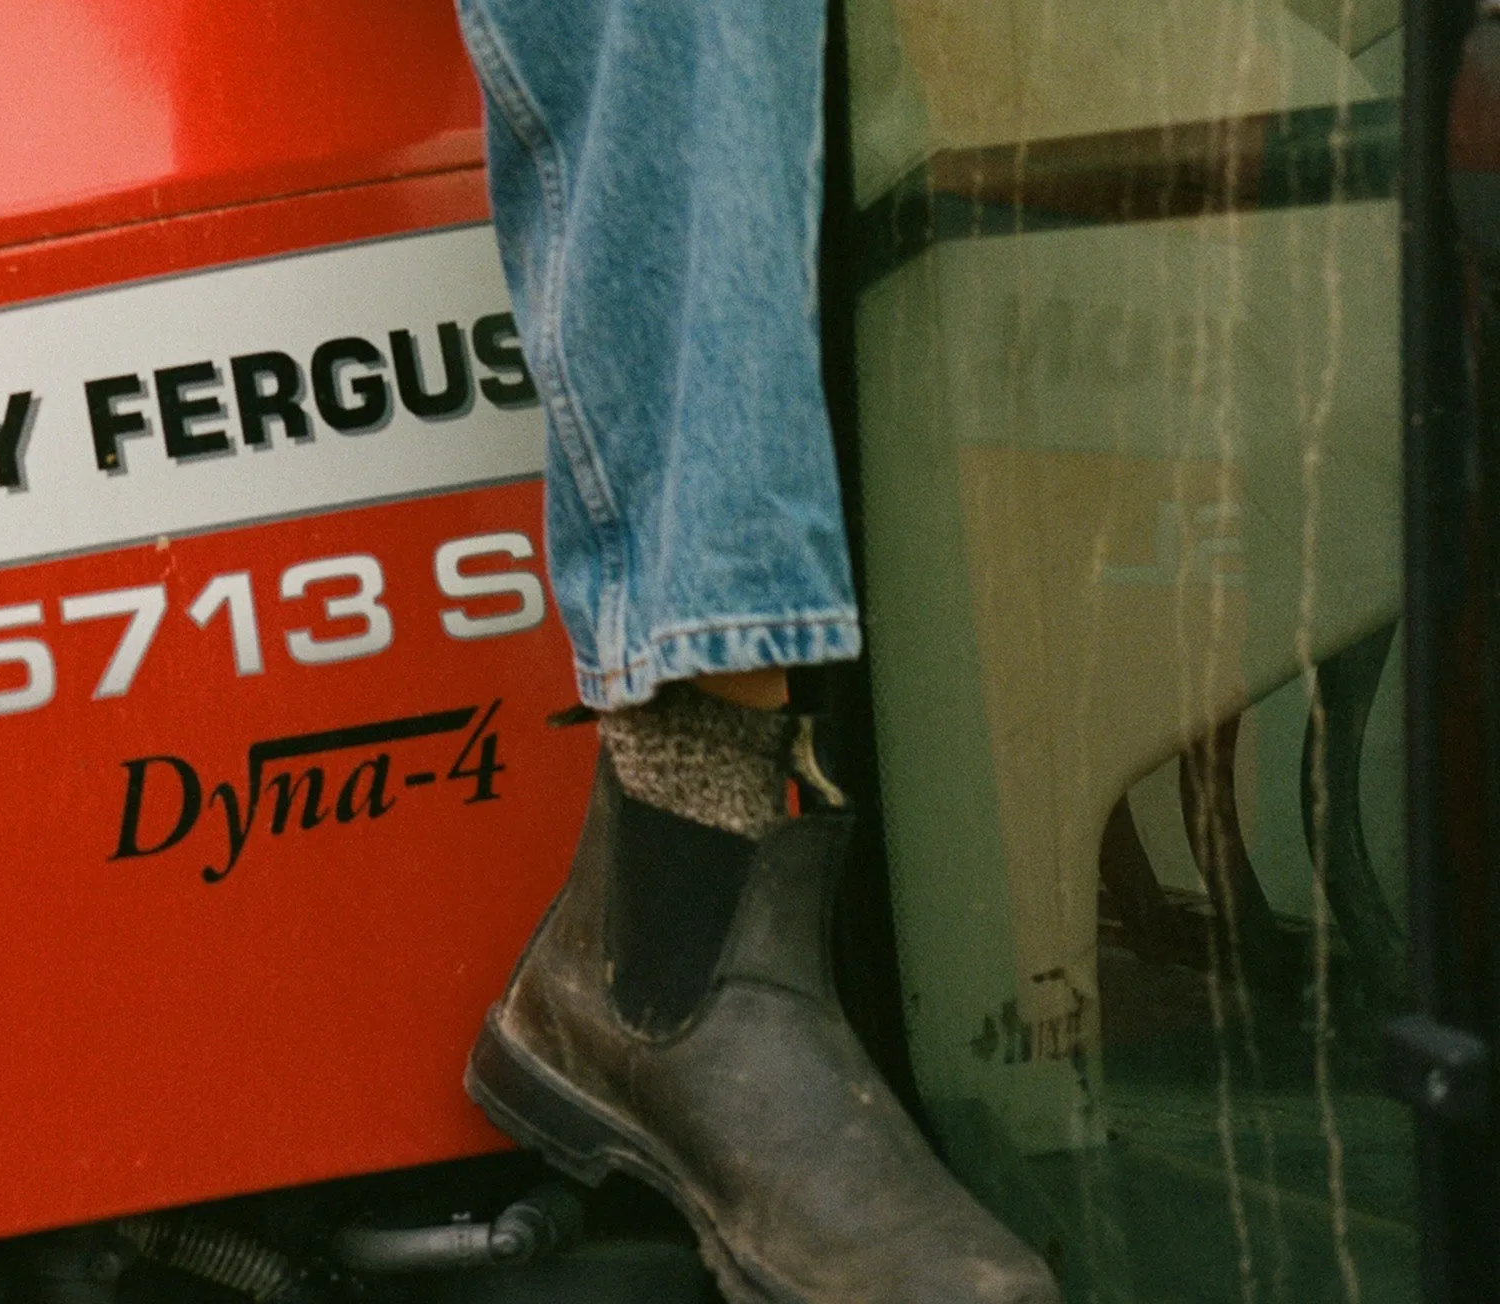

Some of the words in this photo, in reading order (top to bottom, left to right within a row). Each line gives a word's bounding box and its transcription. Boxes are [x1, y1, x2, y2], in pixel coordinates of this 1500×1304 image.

[84, 310, 546, 472] FERGUS
[432, 529, 548, 640] S
[105, 697, 510, 886] Dyna-4
